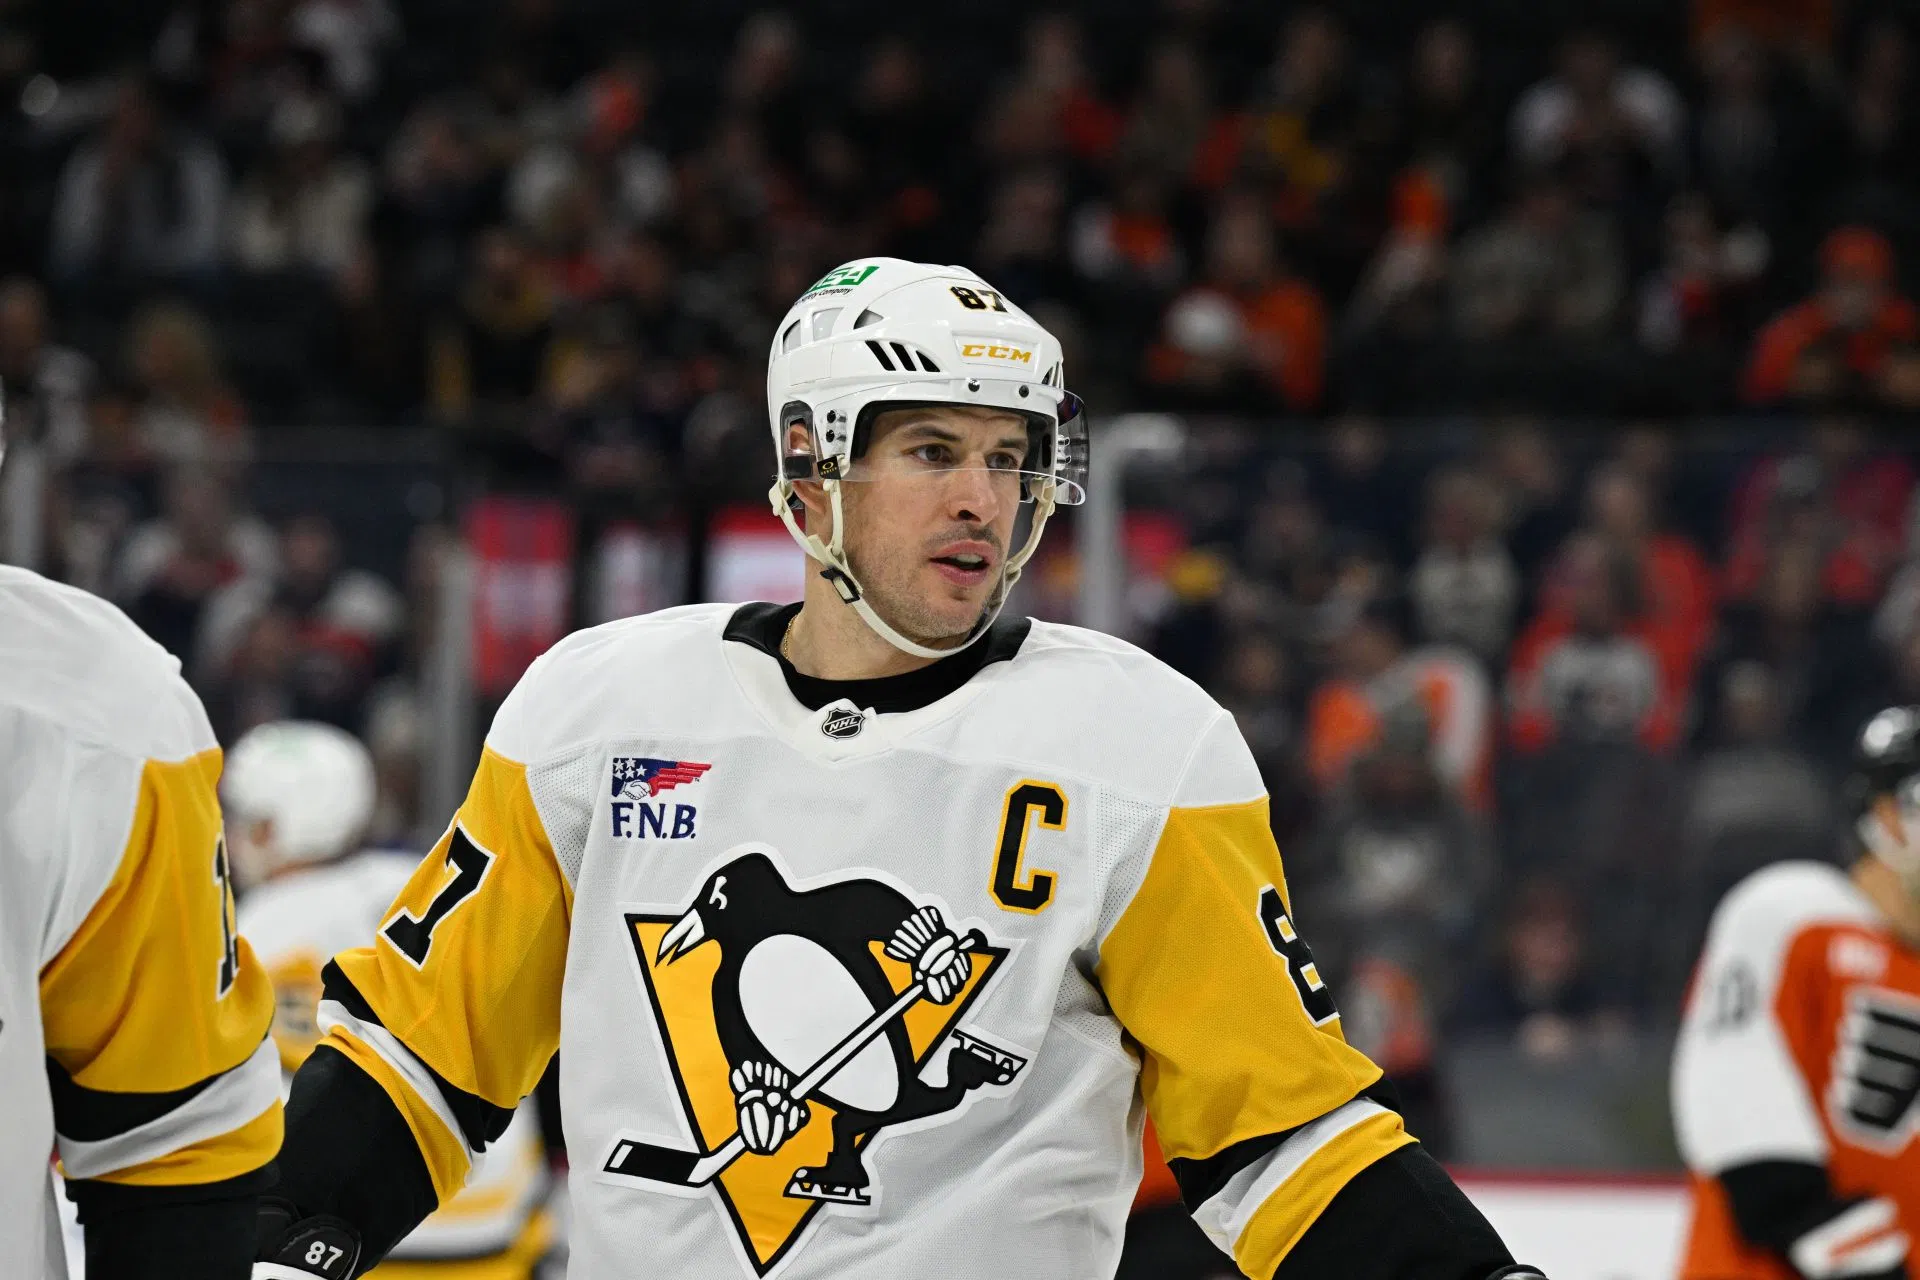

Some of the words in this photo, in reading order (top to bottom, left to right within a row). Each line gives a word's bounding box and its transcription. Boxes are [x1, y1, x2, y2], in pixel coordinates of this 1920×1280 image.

[949, 285, 1009, 313] 87
[961, 344, 1032, 364] CCM
[828, 717, 859, 732] NHL
[610, 801, 697, 840] F.N.B.
[986, 778, 1070, 917] C
[212, 832, 241, 1003] 1
[1256, 883, 1342, 1029] 8
[304, 1240, 344, 1271] 87
